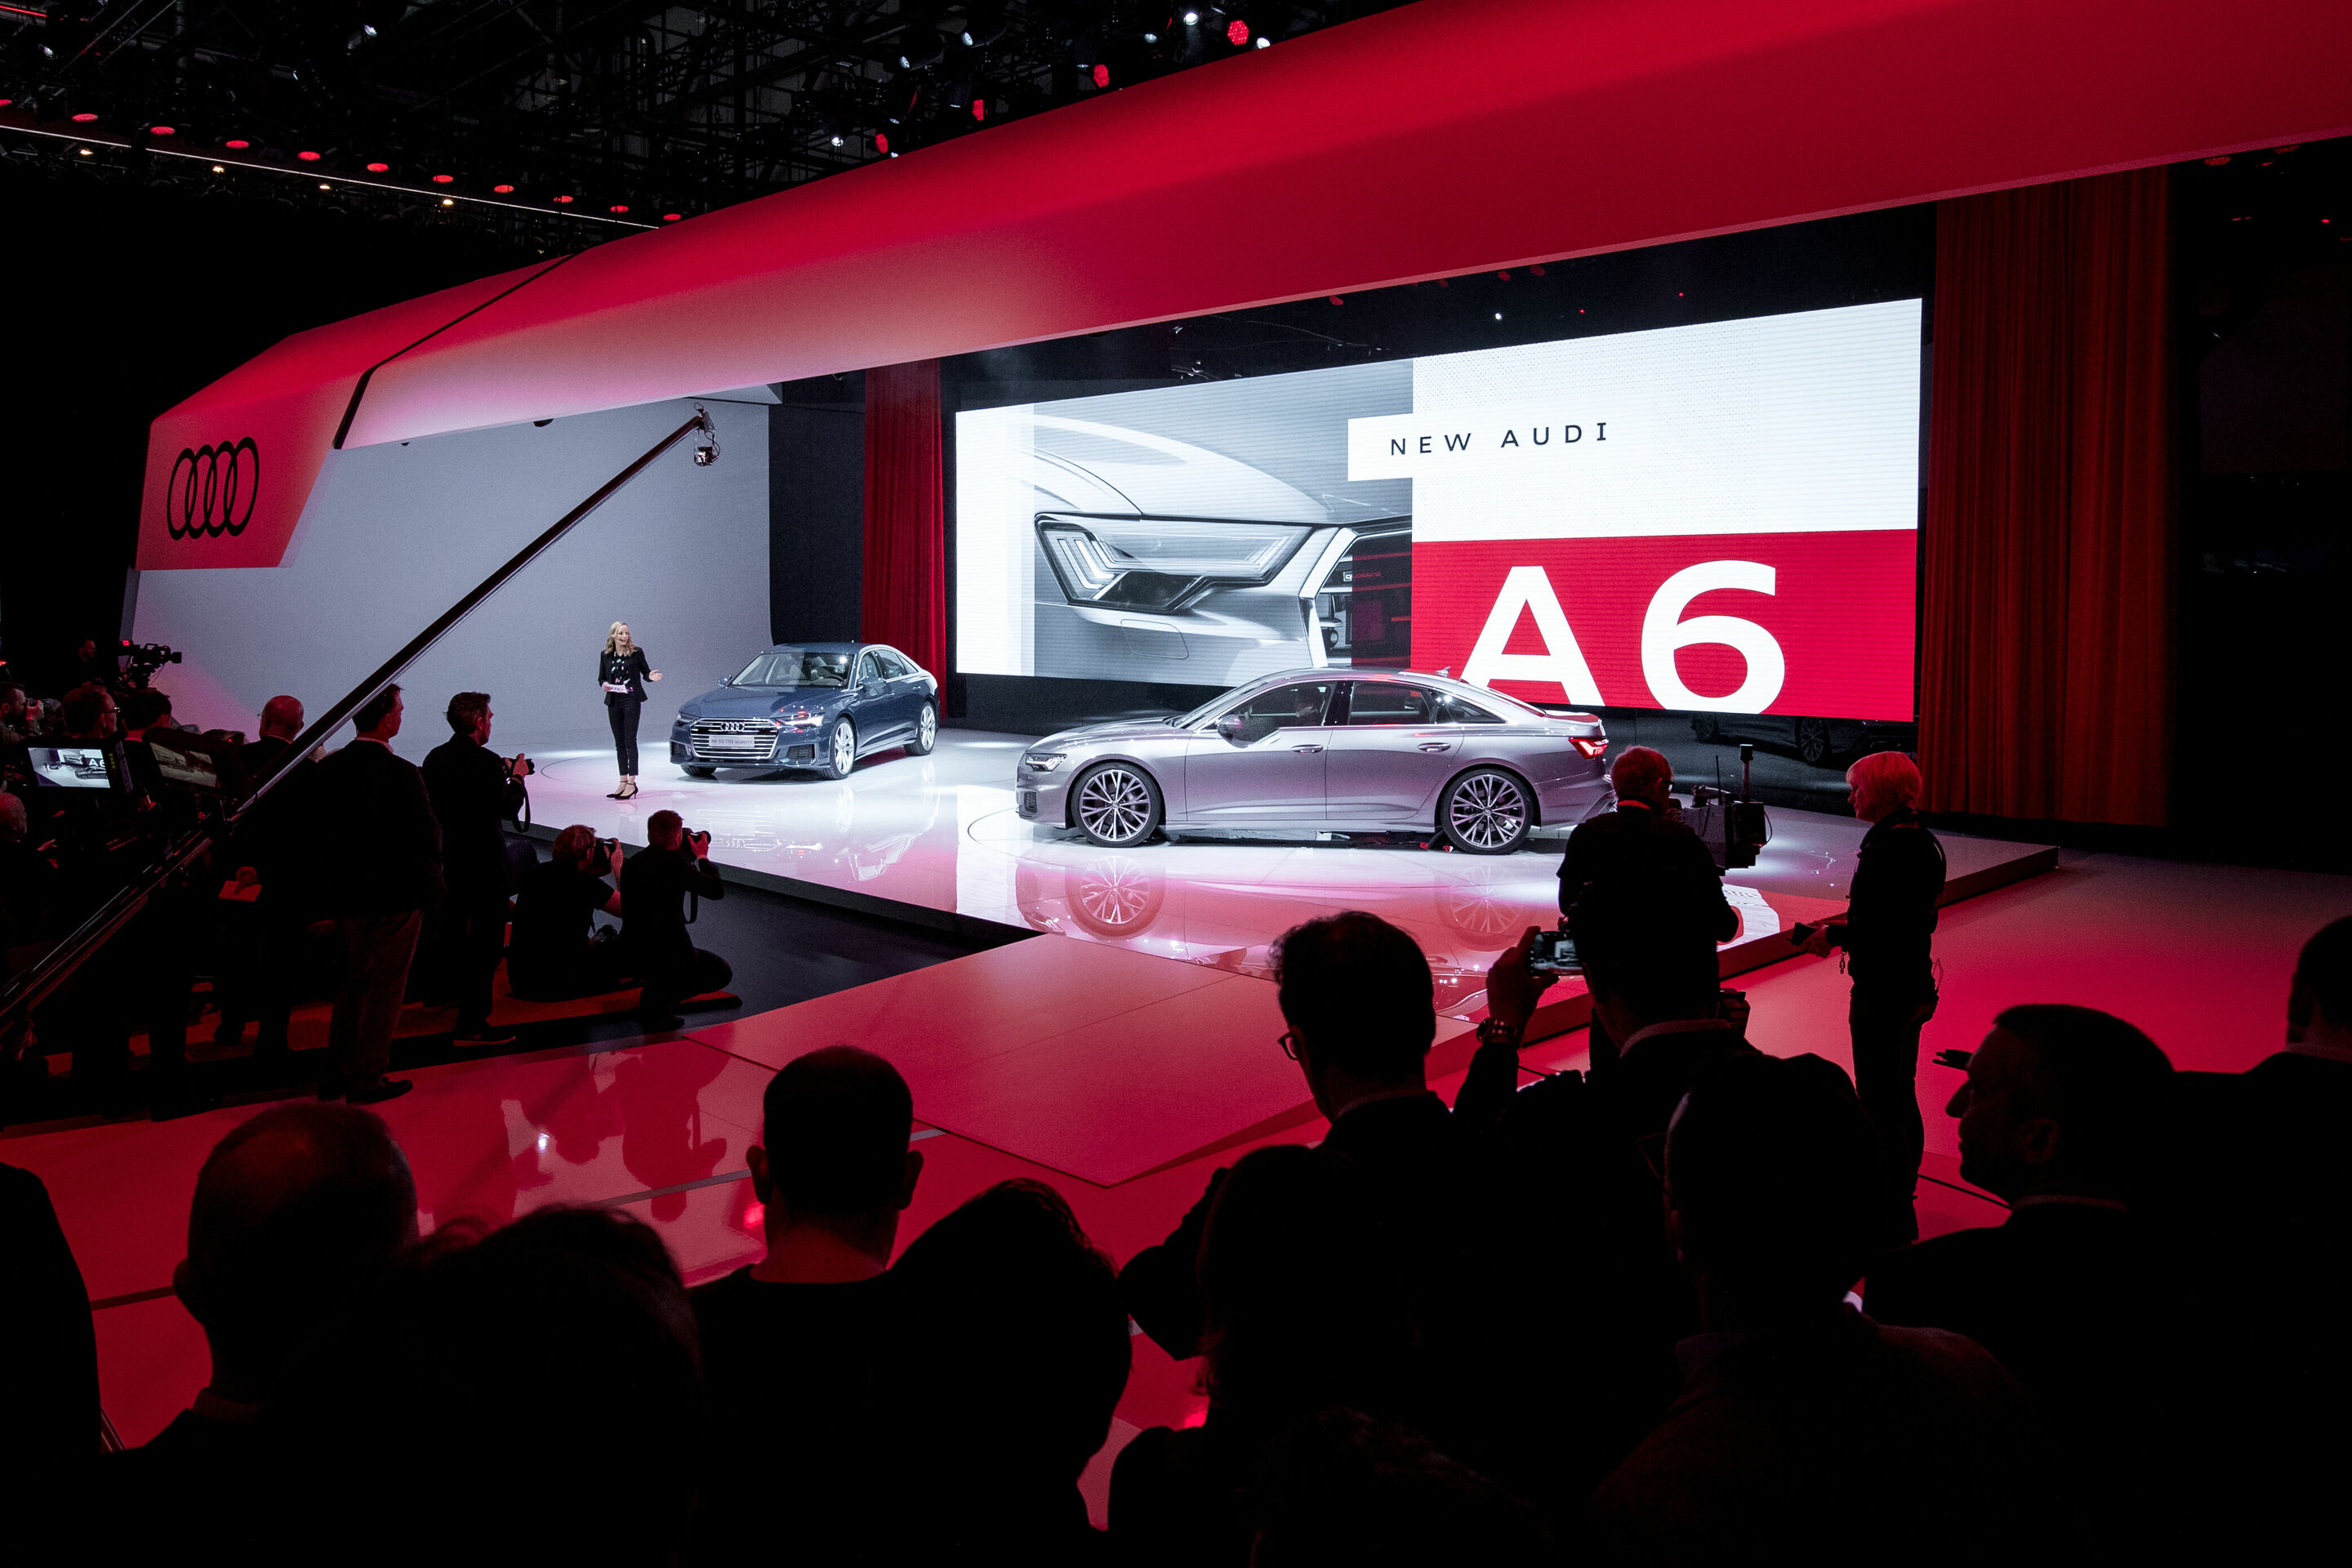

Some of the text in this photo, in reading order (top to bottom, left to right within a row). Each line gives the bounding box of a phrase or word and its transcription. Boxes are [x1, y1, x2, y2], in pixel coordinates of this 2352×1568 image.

[1390, 421, 1607, 456] NEW AUDI
[1459, 559, 1785, 715] A6
